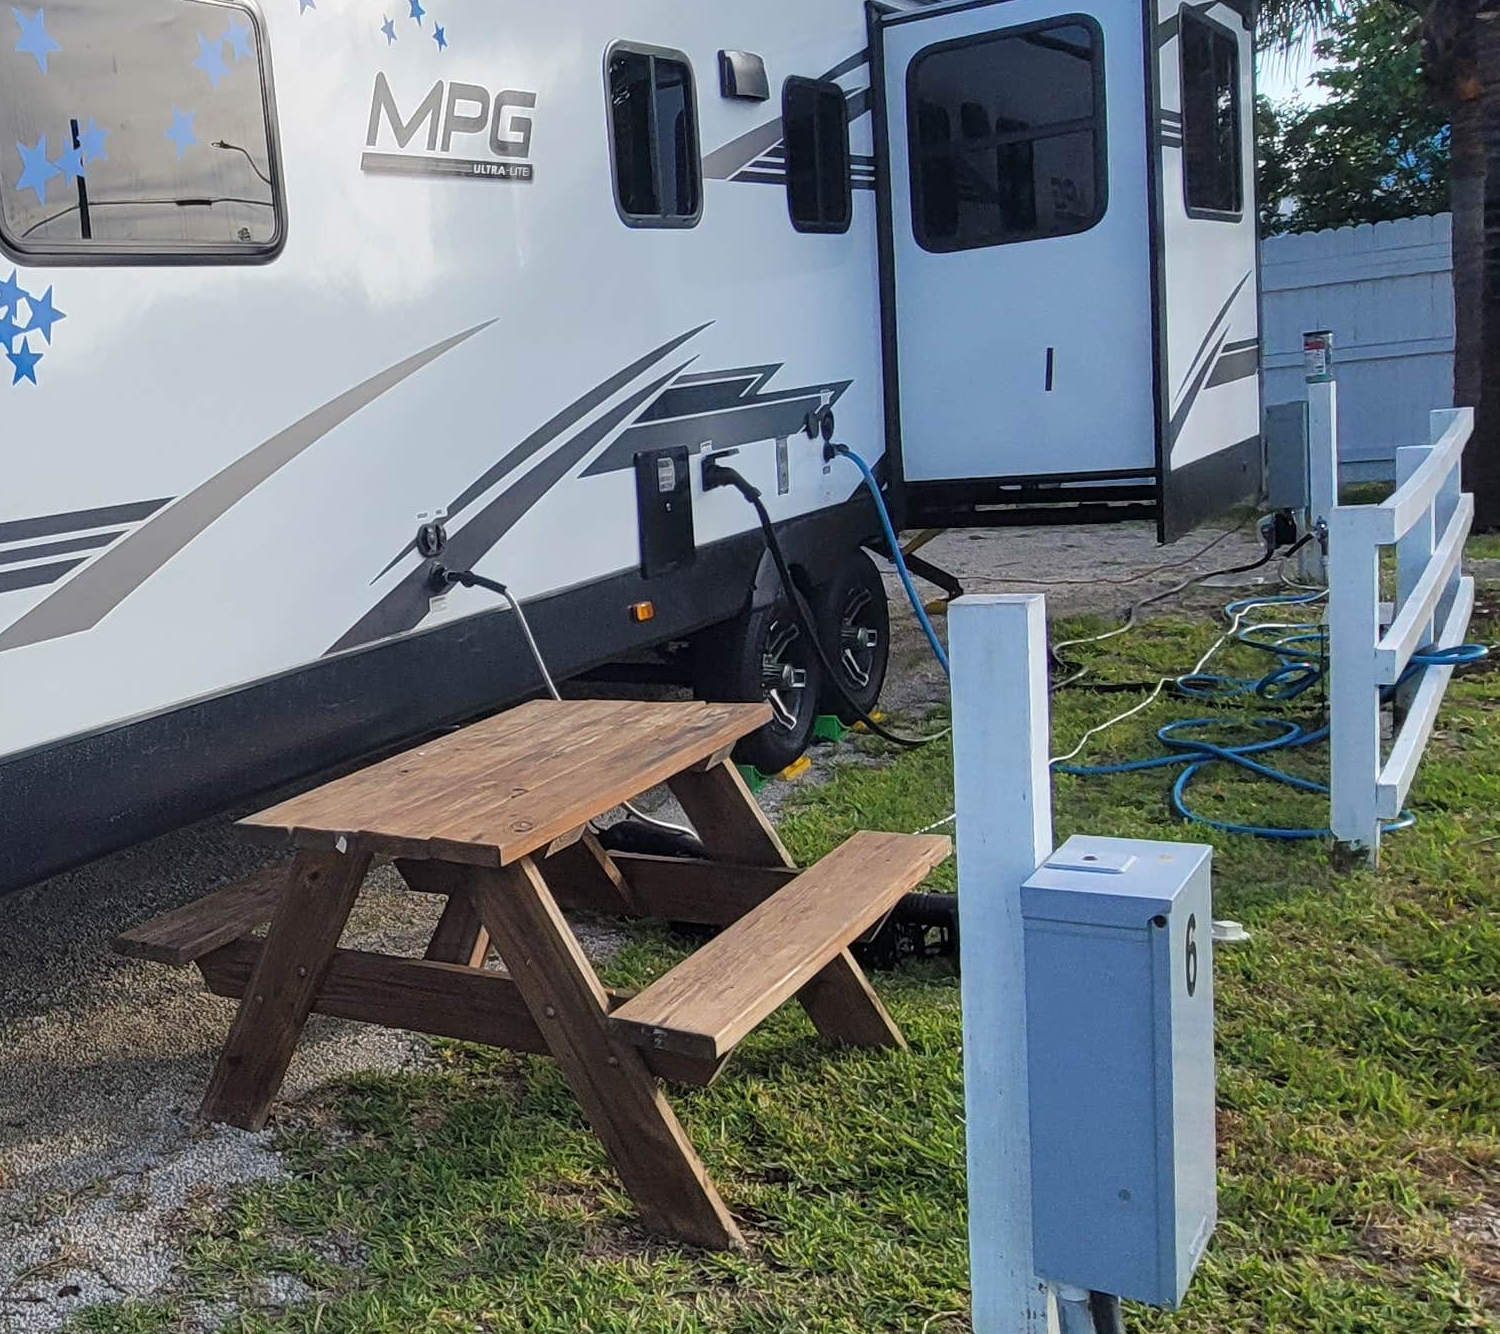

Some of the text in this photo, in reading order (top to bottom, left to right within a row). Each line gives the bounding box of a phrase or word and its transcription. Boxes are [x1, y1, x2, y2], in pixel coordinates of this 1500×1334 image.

[365, 71, 537, 159] MPG
[473, 163, 530, 177] ULTRA-LITE
[1186, 913, 1197, 997] 6
